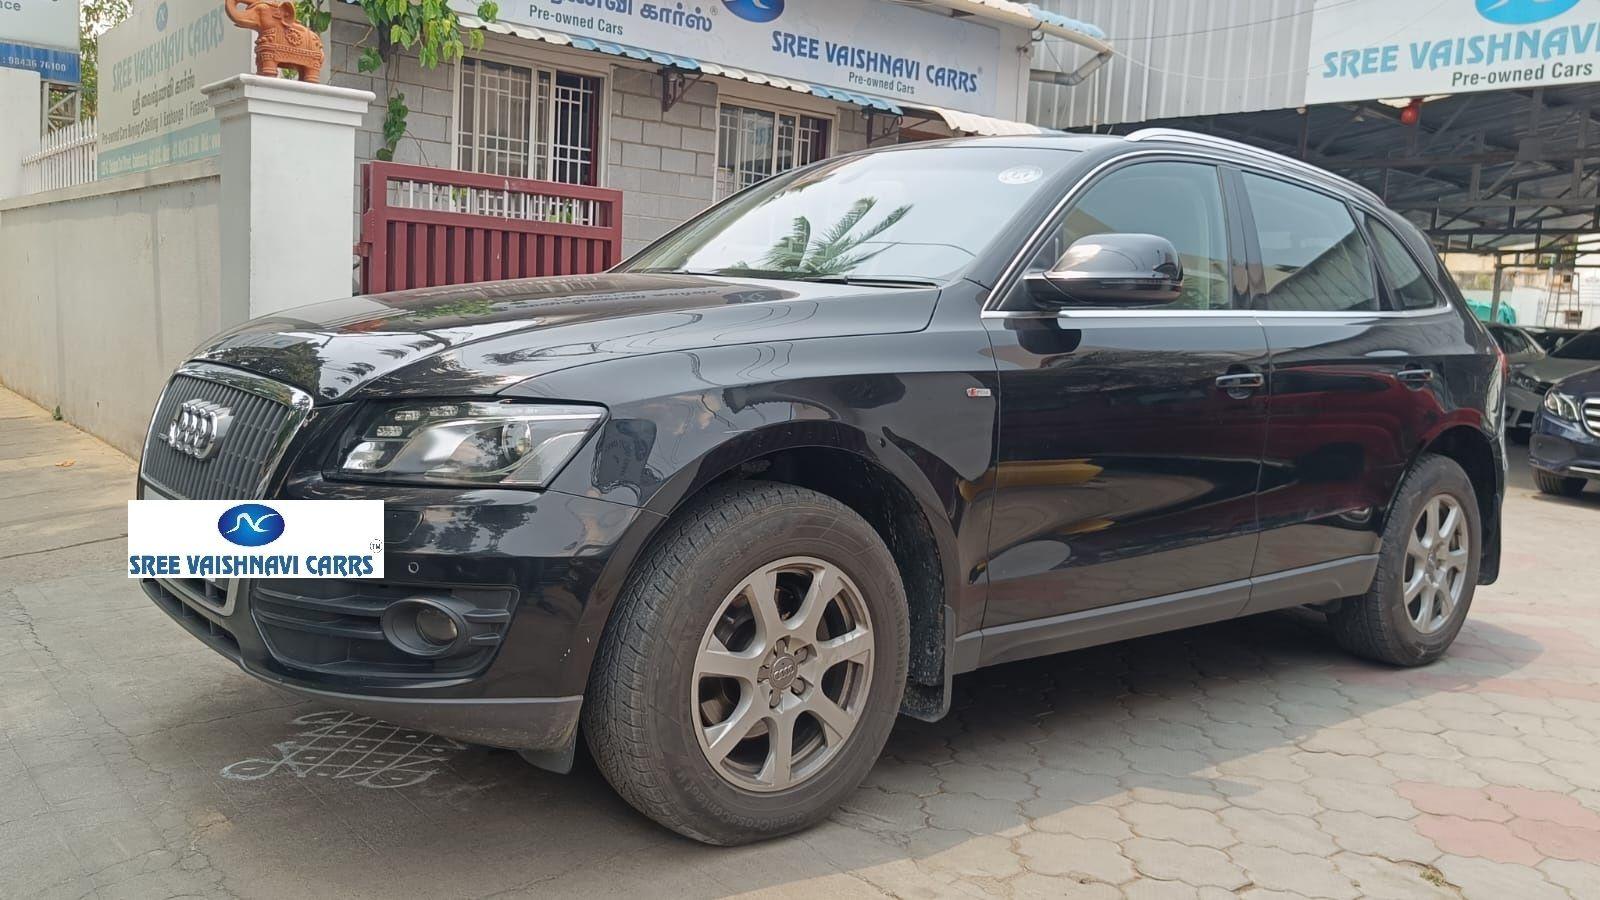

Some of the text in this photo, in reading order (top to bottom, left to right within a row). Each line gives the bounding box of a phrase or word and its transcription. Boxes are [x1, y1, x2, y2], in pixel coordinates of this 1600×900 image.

[530, 4, 594, 29] Pre-owned
[598, 18, 623, 36] Cars
[112, 4, 224, 93] SREE VAISHNAVI CARRS
[771, 30, 978, 94] SREE VAISHNAVI CARRS
[1322, 45, 1399, 79] SREE
[849, 71, 915, 95] Pre-owned Cars
[1452, 61, 1593, 87] Pre-owned Cars
